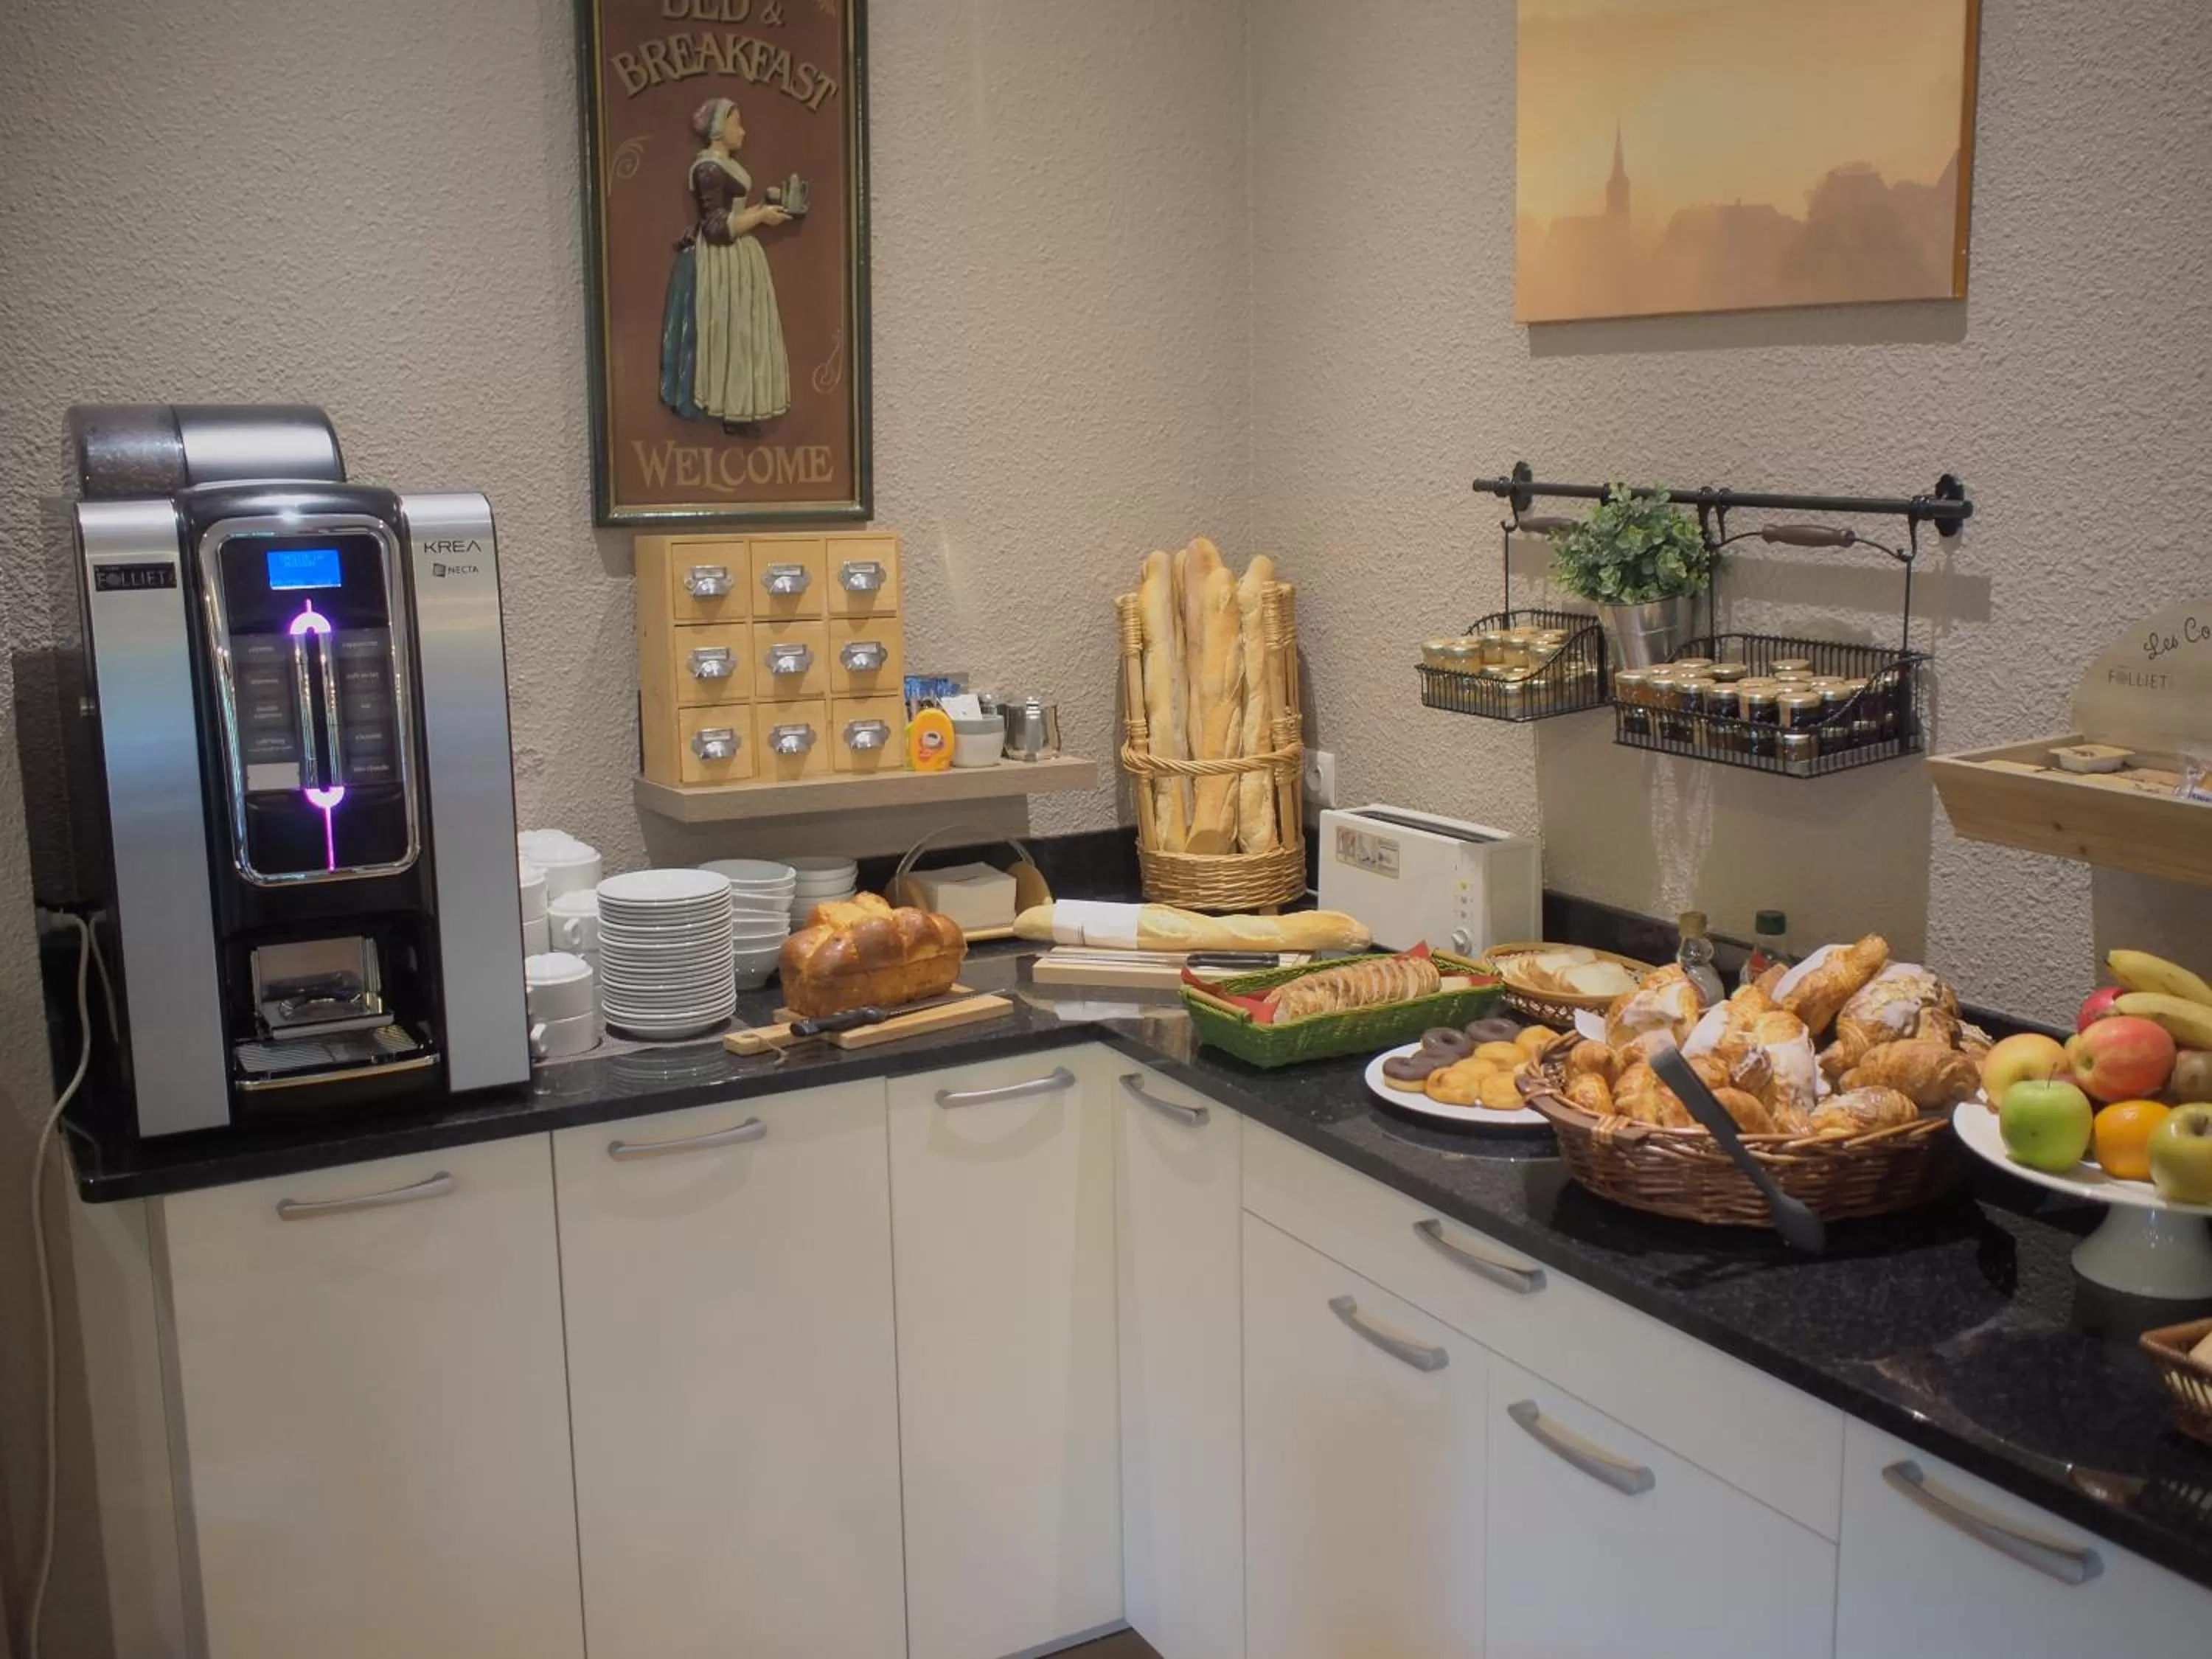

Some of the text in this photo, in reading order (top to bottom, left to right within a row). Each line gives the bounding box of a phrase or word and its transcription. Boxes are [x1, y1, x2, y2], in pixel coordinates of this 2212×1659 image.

[611, 32, 838, 112] BREAKFAST
[631, 440, 835, 493] WELCOME
[424, 540, 482, 554] KREA
